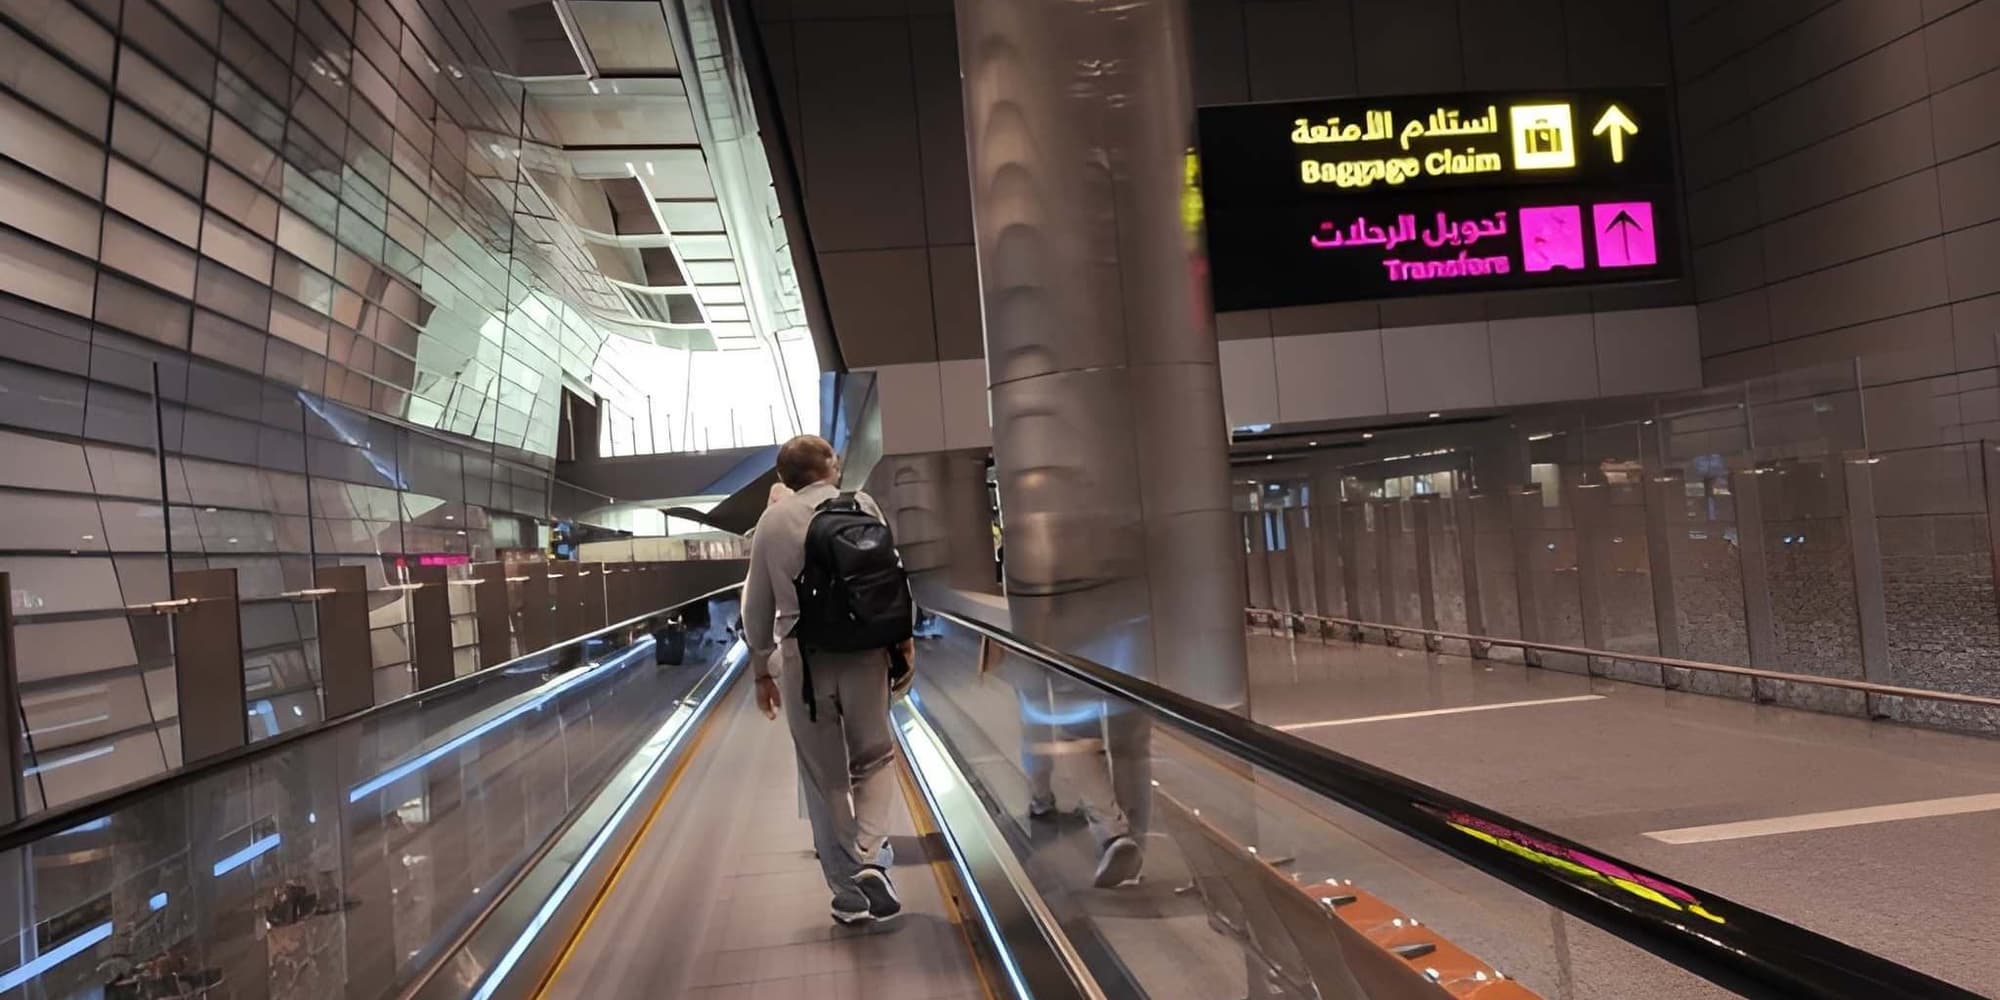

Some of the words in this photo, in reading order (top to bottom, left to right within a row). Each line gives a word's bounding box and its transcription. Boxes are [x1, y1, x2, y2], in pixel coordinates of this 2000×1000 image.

[1400, 105, 1498, 150] استلام
[1301, 157, 1420, 188] Baggage
[1424, 148, 1502, 176] Claim
[1310, 213, 1416, 251] الرحلات
[1422, 211, 1507, 248] تحويل
[1382, 250, 1511, 281] Transfers
